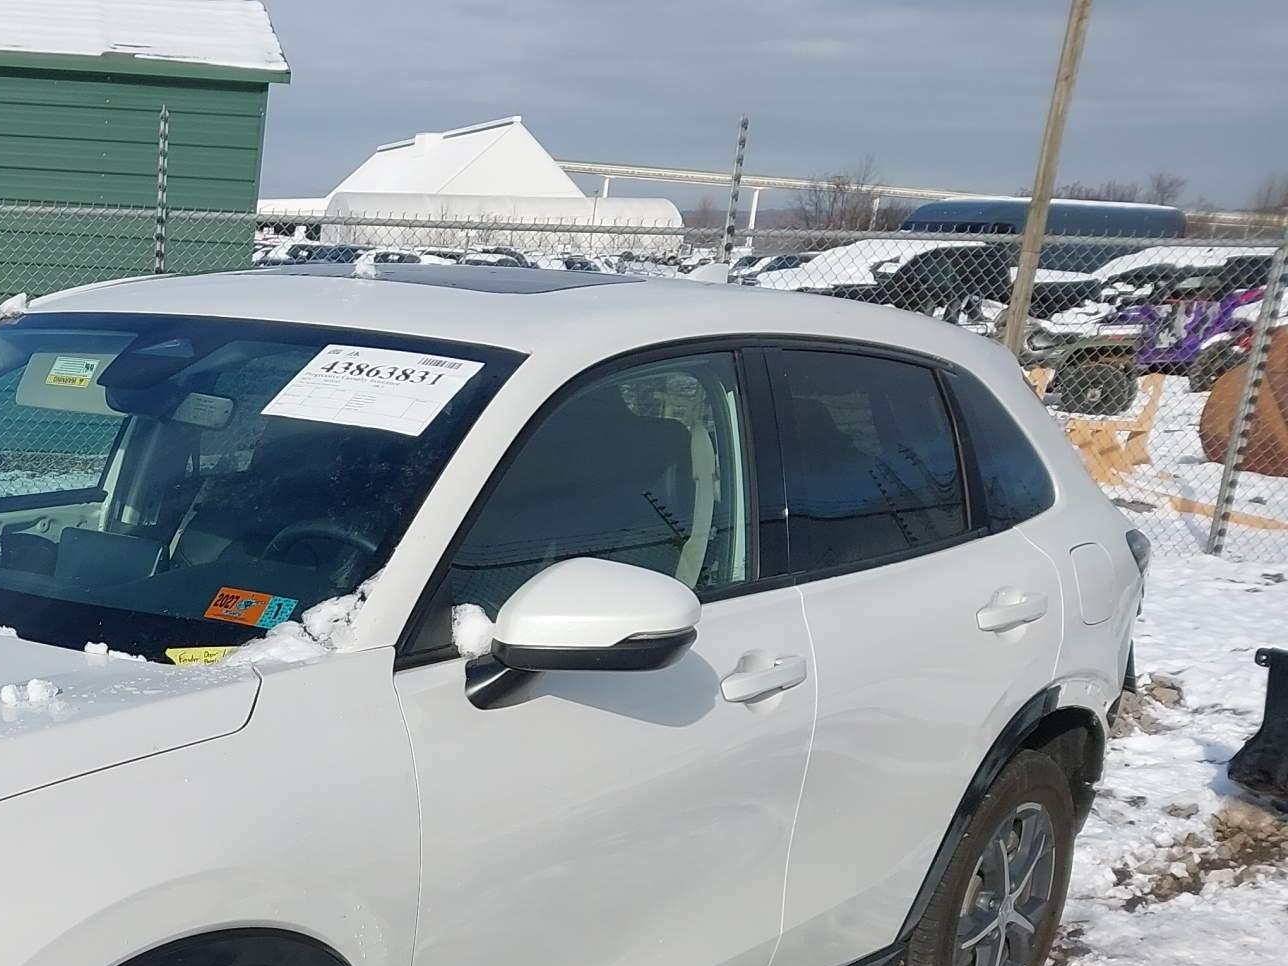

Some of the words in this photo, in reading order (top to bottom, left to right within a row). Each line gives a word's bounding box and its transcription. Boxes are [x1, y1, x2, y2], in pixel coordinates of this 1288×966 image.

[320, 360, 445, 386] 43863831
[213, 592, 241, 610] 2027
[273, 602, 283, 620] 1
